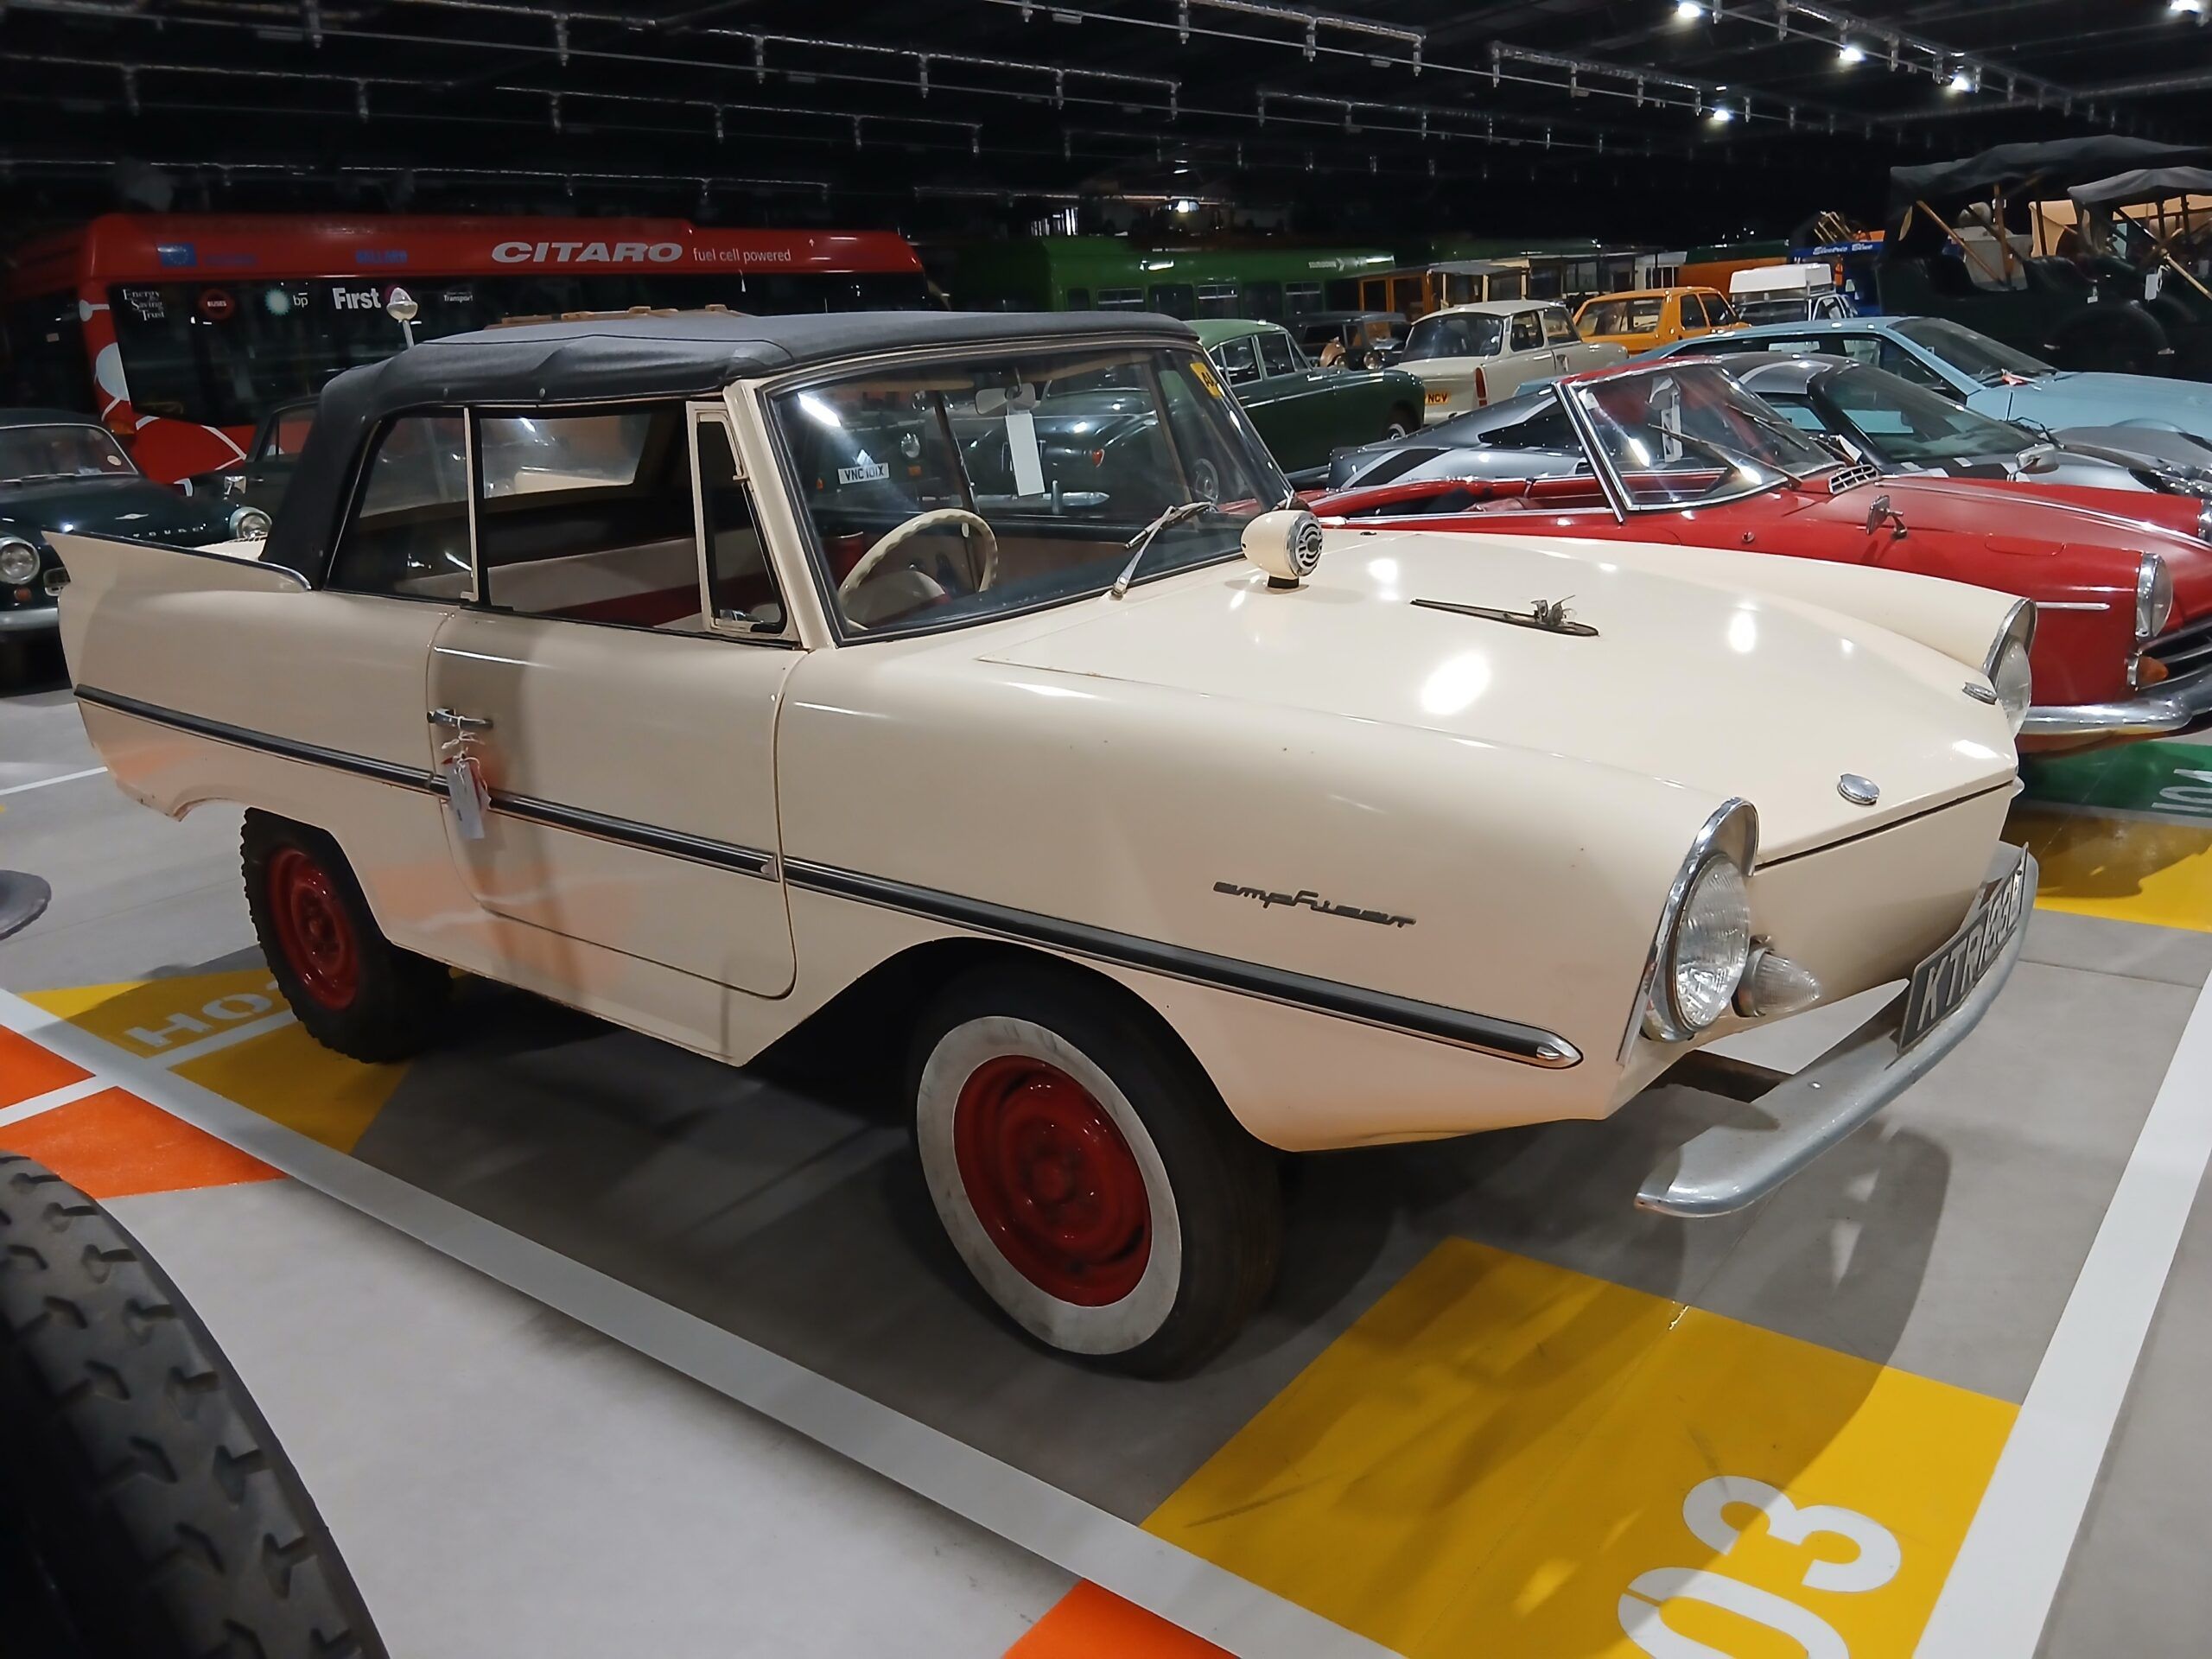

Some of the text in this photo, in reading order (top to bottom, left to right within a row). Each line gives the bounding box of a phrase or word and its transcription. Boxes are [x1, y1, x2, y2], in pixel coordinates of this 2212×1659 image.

[492, 242, 683, 263] CITARO
[693, 247, 791, 264] fuel cell powered
[123, 289, 160, 300] Energy
[332, 288, 381, 309] First
[443, 294, 473, 302] Transport
[131, 300, 164, 310] Saving
[293, 295, 308, 308] bp
[141, 309, 164, 321] Trust
[1427, 393, 1448, 404] NCV
[844, 468, 865, 480] VNC
